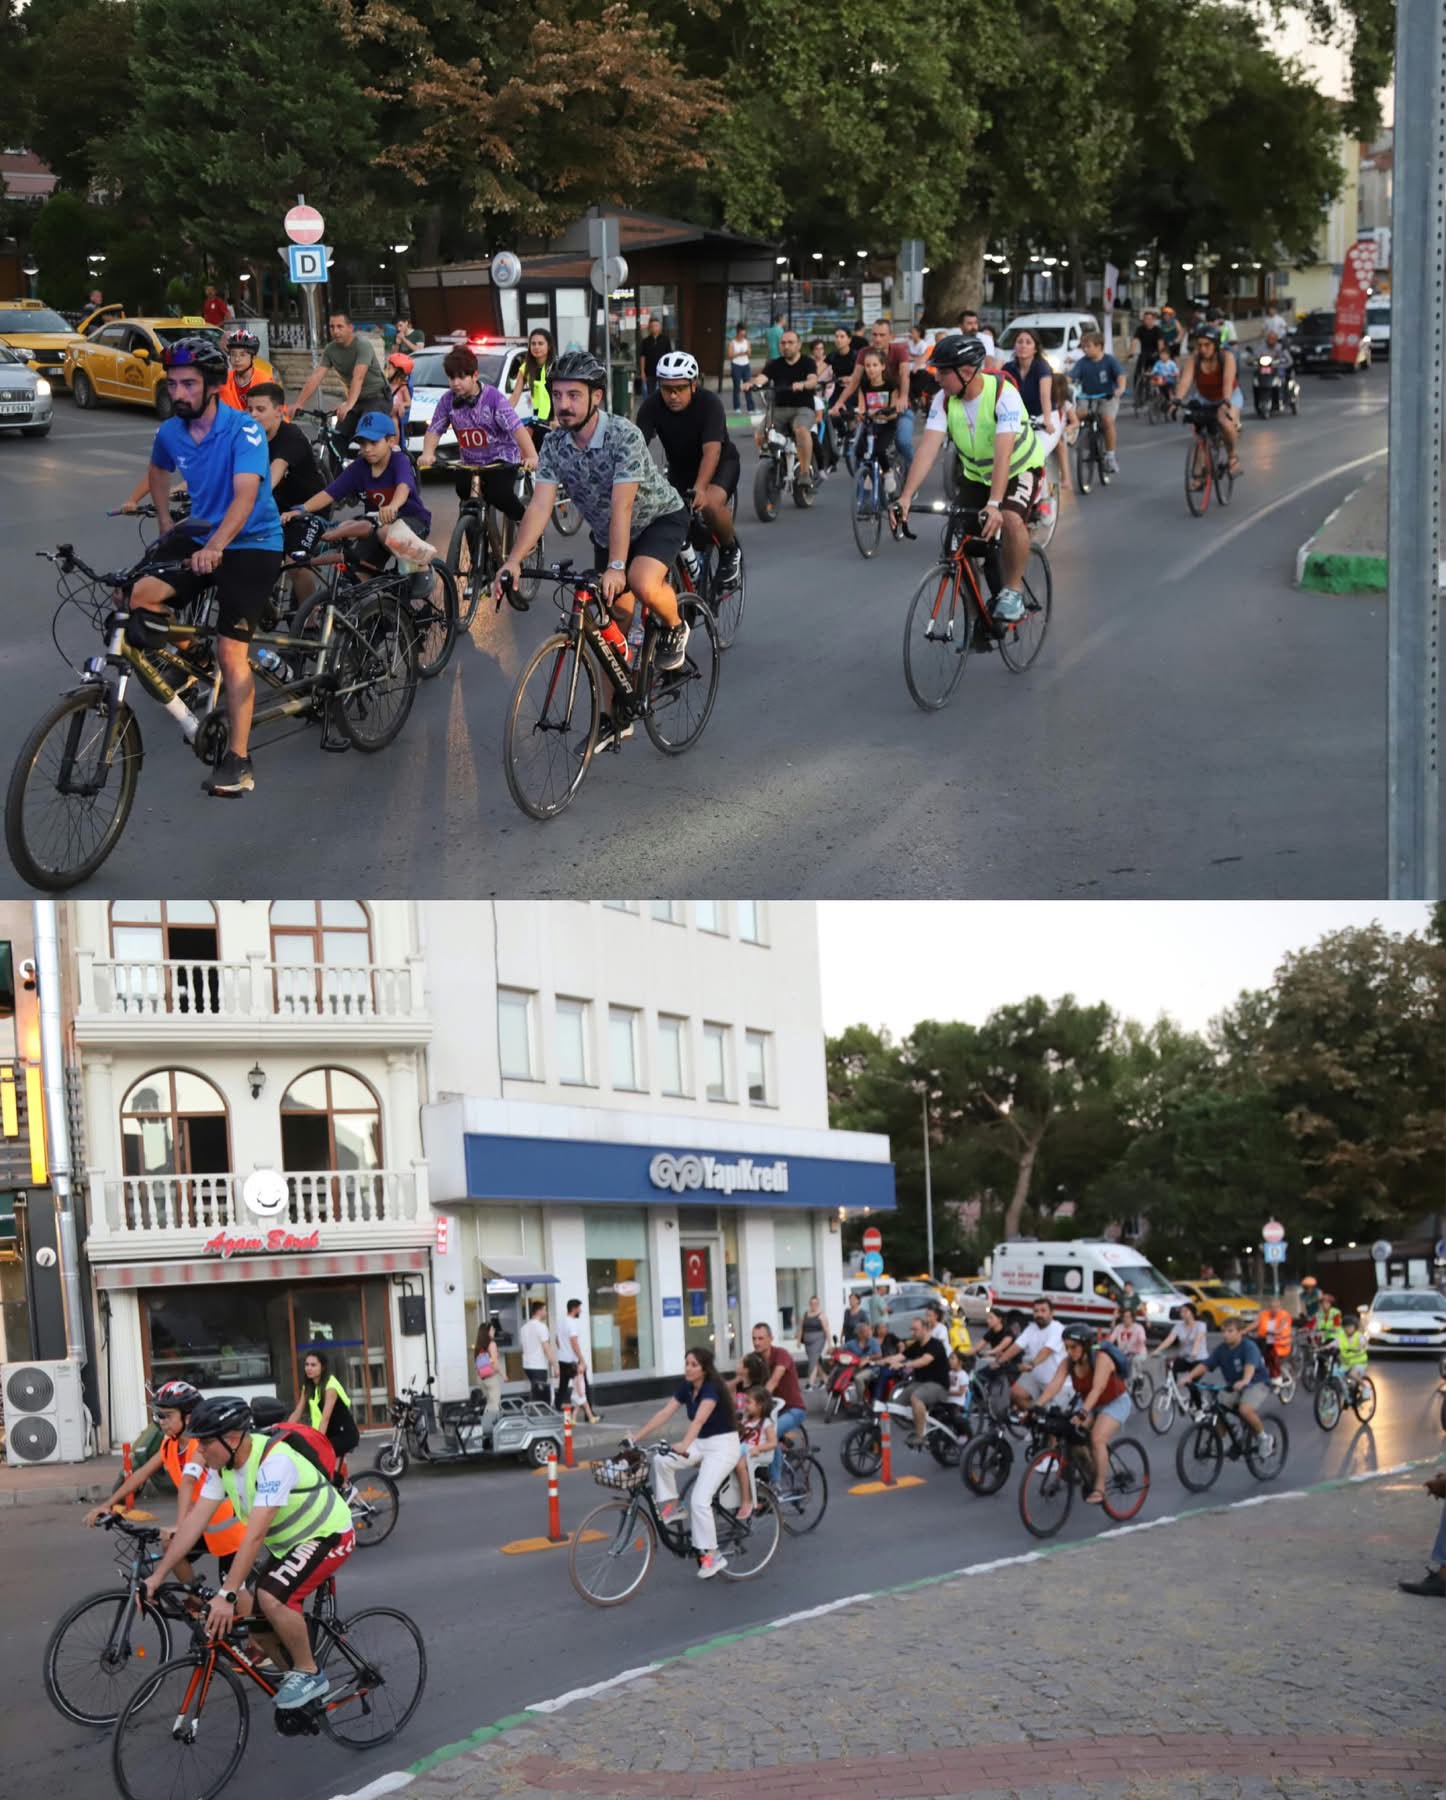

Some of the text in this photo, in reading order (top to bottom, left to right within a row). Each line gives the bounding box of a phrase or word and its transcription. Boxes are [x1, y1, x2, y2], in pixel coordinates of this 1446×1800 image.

[300, 254, 317, 274] D
[461, 430, 484, 447] 10
[592, 630, 634, 694] MERIDA
[1270, 1248, 1281, 1259] D
